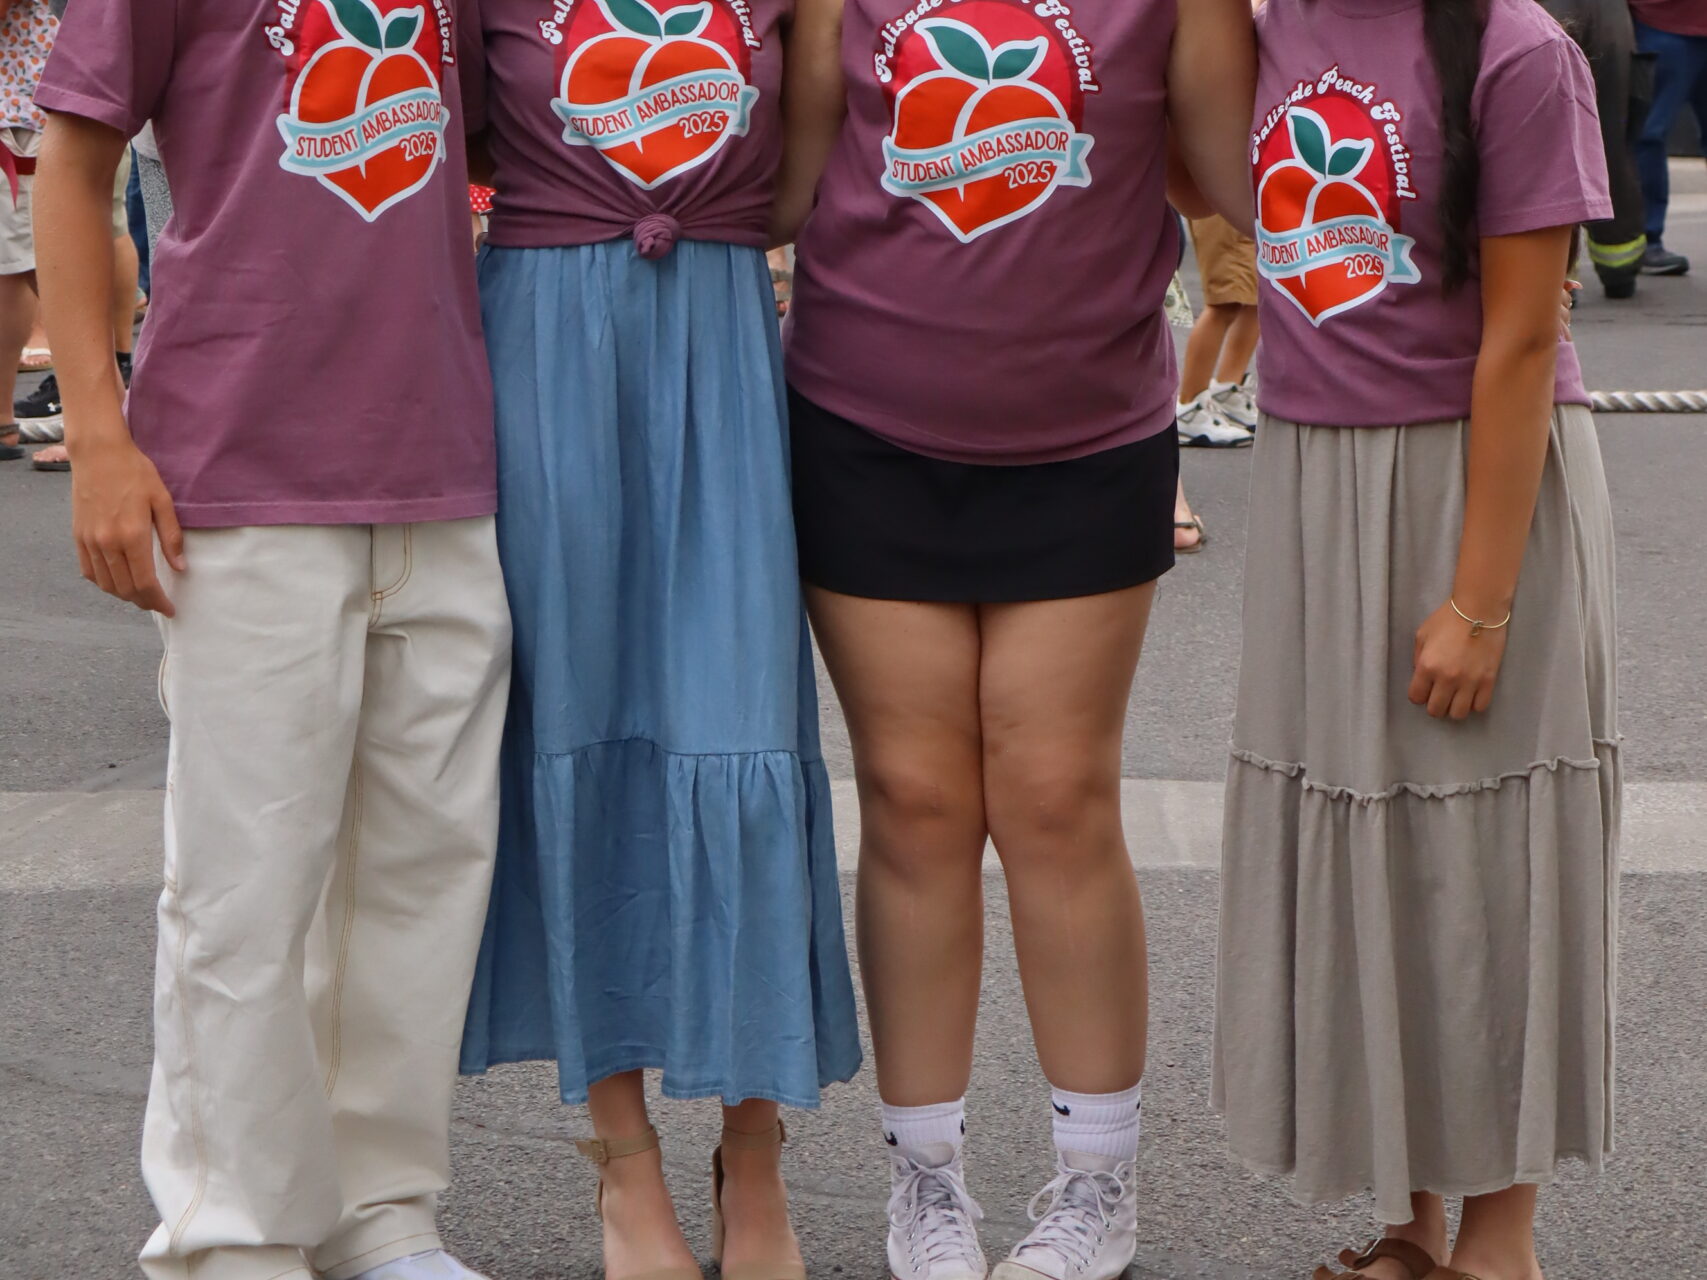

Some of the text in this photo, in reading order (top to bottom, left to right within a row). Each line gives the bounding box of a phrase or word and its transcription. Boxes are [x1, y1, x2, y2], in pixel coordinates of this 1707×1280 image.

[570, 81, 740, 137] STUDENT AMBASSADOR
[679, 113, 724, 139] 2025
[1317, 65, 1376, 104] Peach
[1370, 101, 1416, 200] Festival
[296, 129, 359, 158] STUDENT
[400, 133, 435, 161] 2025
[892, 131, 1069, 182] STUDENT AMBASSADOR
[1004, 163, 1051, 189] 2025
[1261, 226, 1389, 265] STUDENT AMBASSADOR
[1344, 256, 1383, 279] 2025
